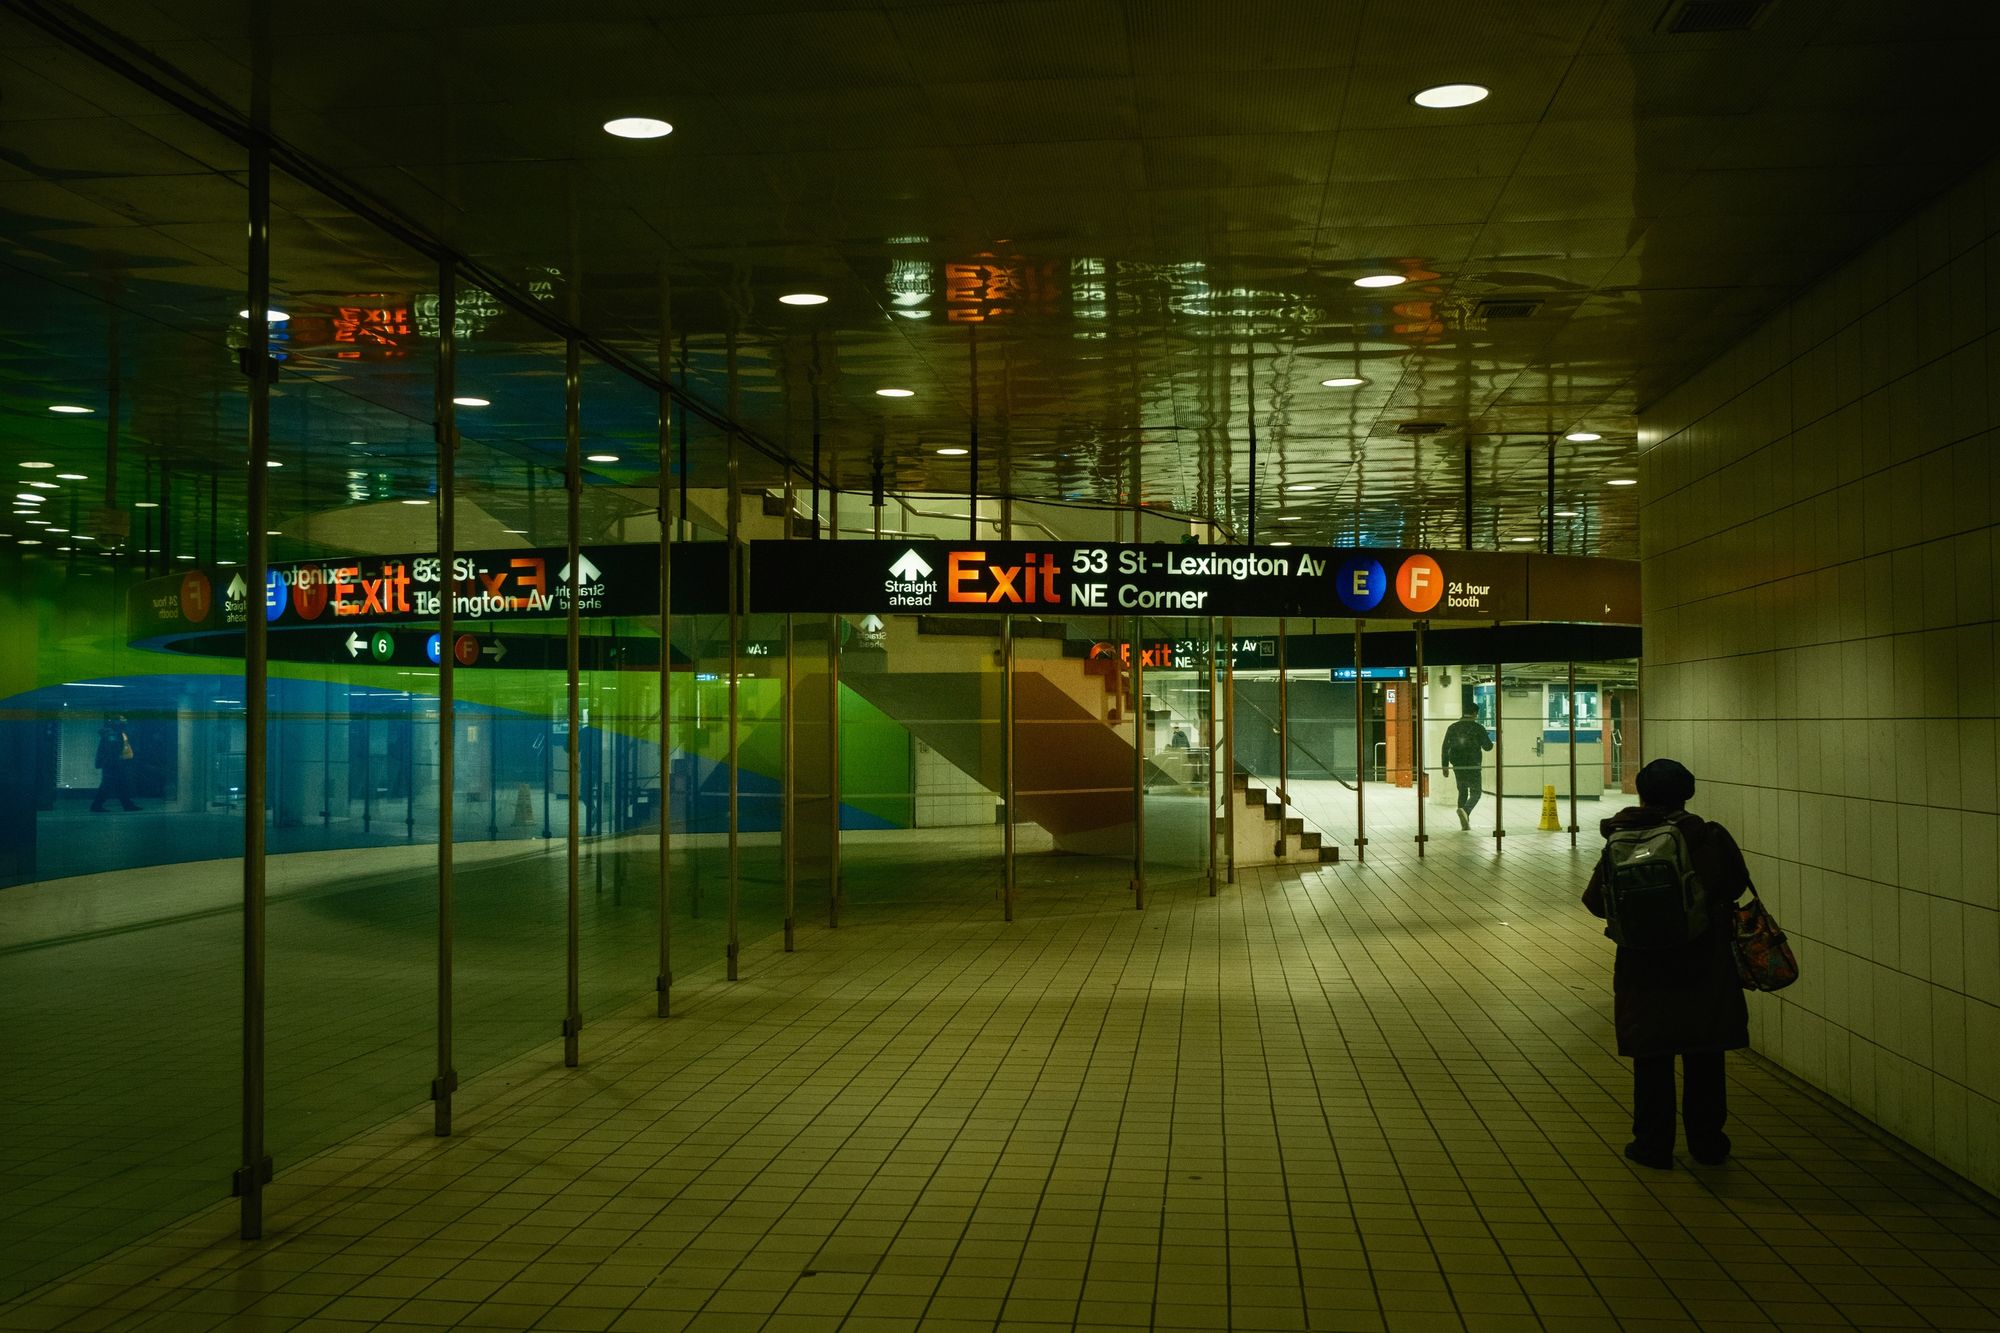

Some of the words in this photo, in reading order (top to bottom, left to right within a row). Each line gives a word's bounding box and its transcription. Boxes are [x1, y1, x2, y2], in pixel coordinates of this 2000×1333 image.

[1072, 549, 1108, 574] 53
[1296, 553, 1326, 577] Av
[947, 550, 1062, 604] Exit
[1353, 570, 1369, 595] E
[1410, 567, 1431, 599] F
[335, 564, 411, 615] Exit
[885, 580, 938, 595] Straight
[1071, 583, 1108, 607] NE
[1118, 584, 1208, 609] Corner
[1448, 582, 1462, 594] 24
[1466, 583, 1490, 595] hour
[418, 590, 517, 617] Leington
[526, 589, 554, 611] Av
[889, 594, 932, 606] ahead
[1448, 596, 1480, 607] booth
[378, 639, 387, 653] 6
[1242, 640, 1257, 652] Av
[1175, 657, 1193, 668] NE
